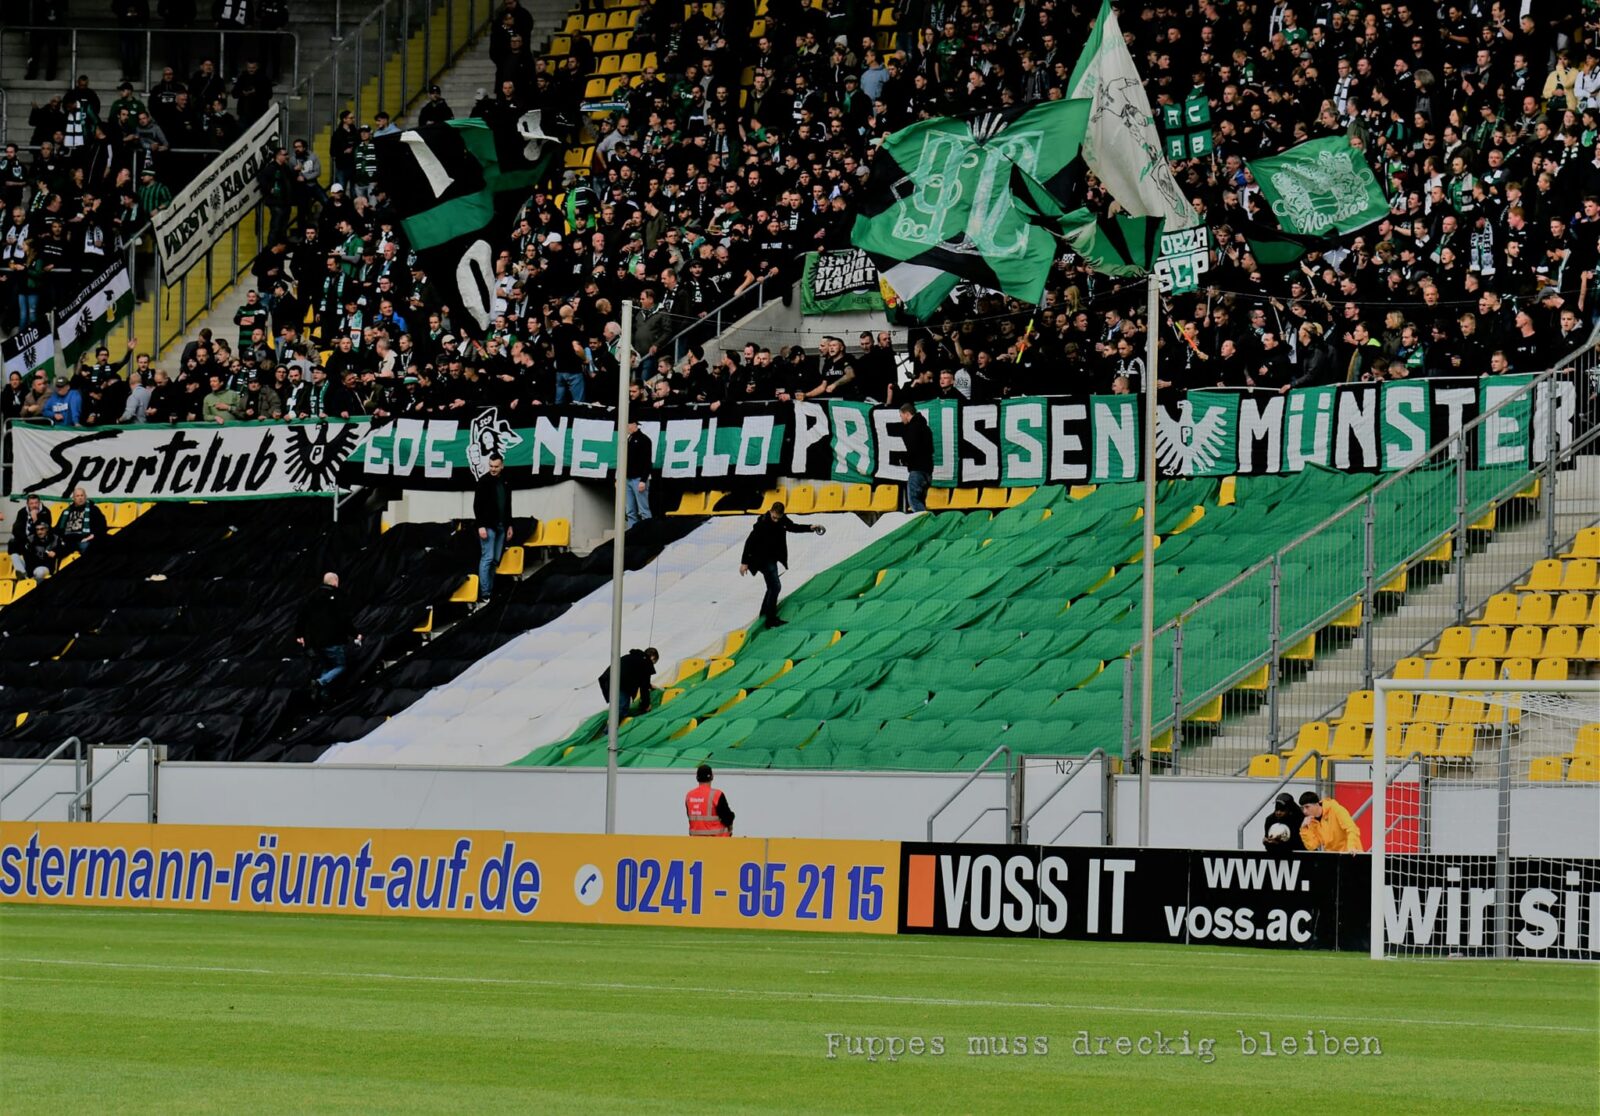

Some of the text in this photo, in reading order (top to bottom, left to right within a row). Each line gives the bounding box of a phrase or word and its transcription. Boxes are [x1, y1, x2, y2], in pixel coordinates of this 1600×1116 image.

[163, 199, 209, 260] WEST
[815, 267, 876, 293] VERBOT
[1154, 251, 1209, 293] SCP
[14, 327, 39, 351] Linie
[1238, 381, 1577, 473] MÜNSTER
[23, 428, 277, 498] Sportclub
[1055, 760, 1074, 775] N2
[0, 831, 541, 916] stermann-räumt-auf.de
[615, 858, 704, 915] 0241
[738, 862, 787, 918] 95
[796, 864, 836, 919] 21
[847, 866, 885, 921] 15
[940, 854, 1136, 935] VOSS IT
[1203, 858, 1310, 892] www.
[1164, 905, 1312, 943] voss.ac
[1384, 867, 1600, 951] wir si
